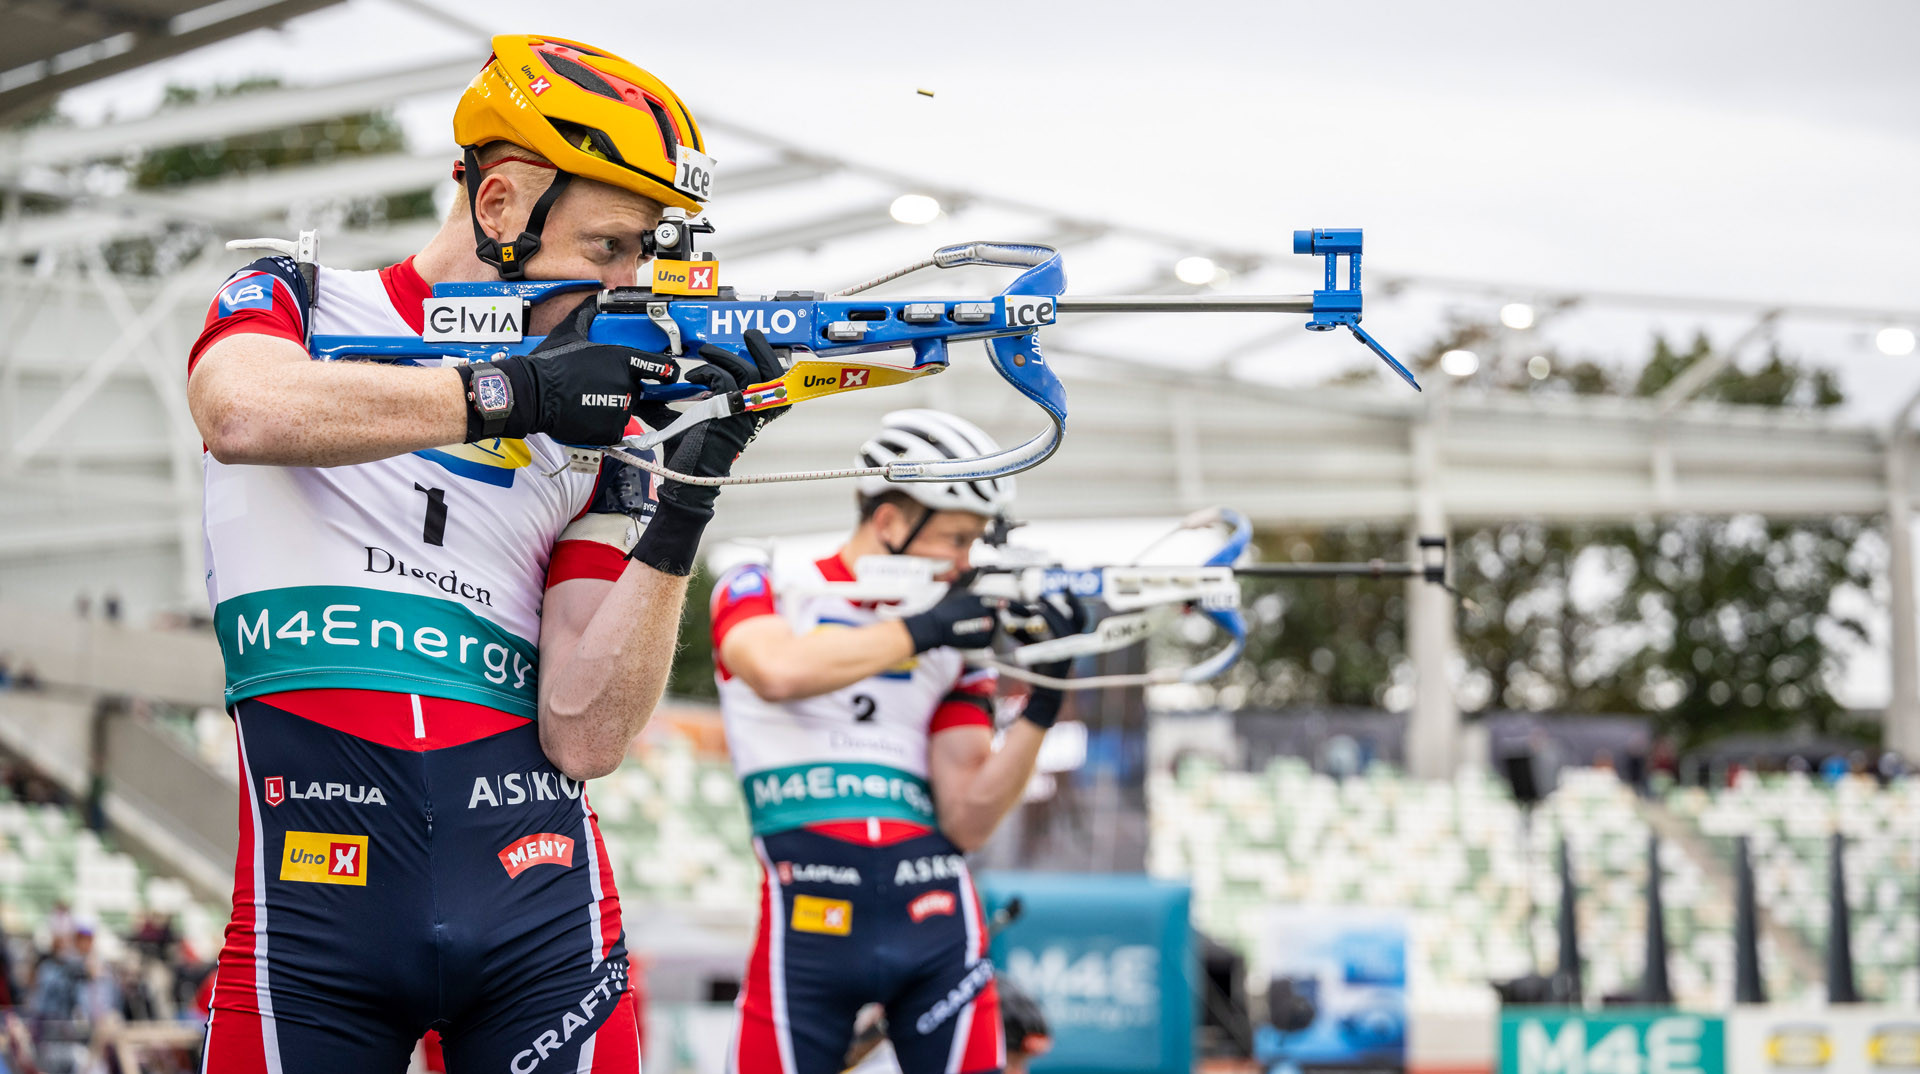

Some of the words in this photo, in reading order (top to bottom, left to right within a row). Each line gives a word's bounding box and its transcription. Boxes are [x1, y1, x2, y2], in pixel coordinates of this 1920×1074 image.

[521, 65, 535, 80] Uno
[530, 78, 551, 95] X
[680, 162, 710, 197] ice
[657, 270, 686, 283] Uno
[691, 268, 711, 288] X
[1005, 302, 1053, 327] ice
[1031, 331, 1044, 365] LAR
[803, 375, 836, 388] Uno
[843, 370, 868, 387] X
[414, 481, 448, 547] 1
[364, 546, 493, 607] Dresden
[237, 604, 532, 689] M4Energy
[852, 694, 876, 722] 2
[289, 780, 387, 806] LAPUA
[290, 848, 326, 865] Uno
[332, 846, 358, 874] X
[507, 840, 567, 868] MENY
[510, 975, 612, 1074] CRAFT
[1516, 1014, 1706, 1074] M4E
